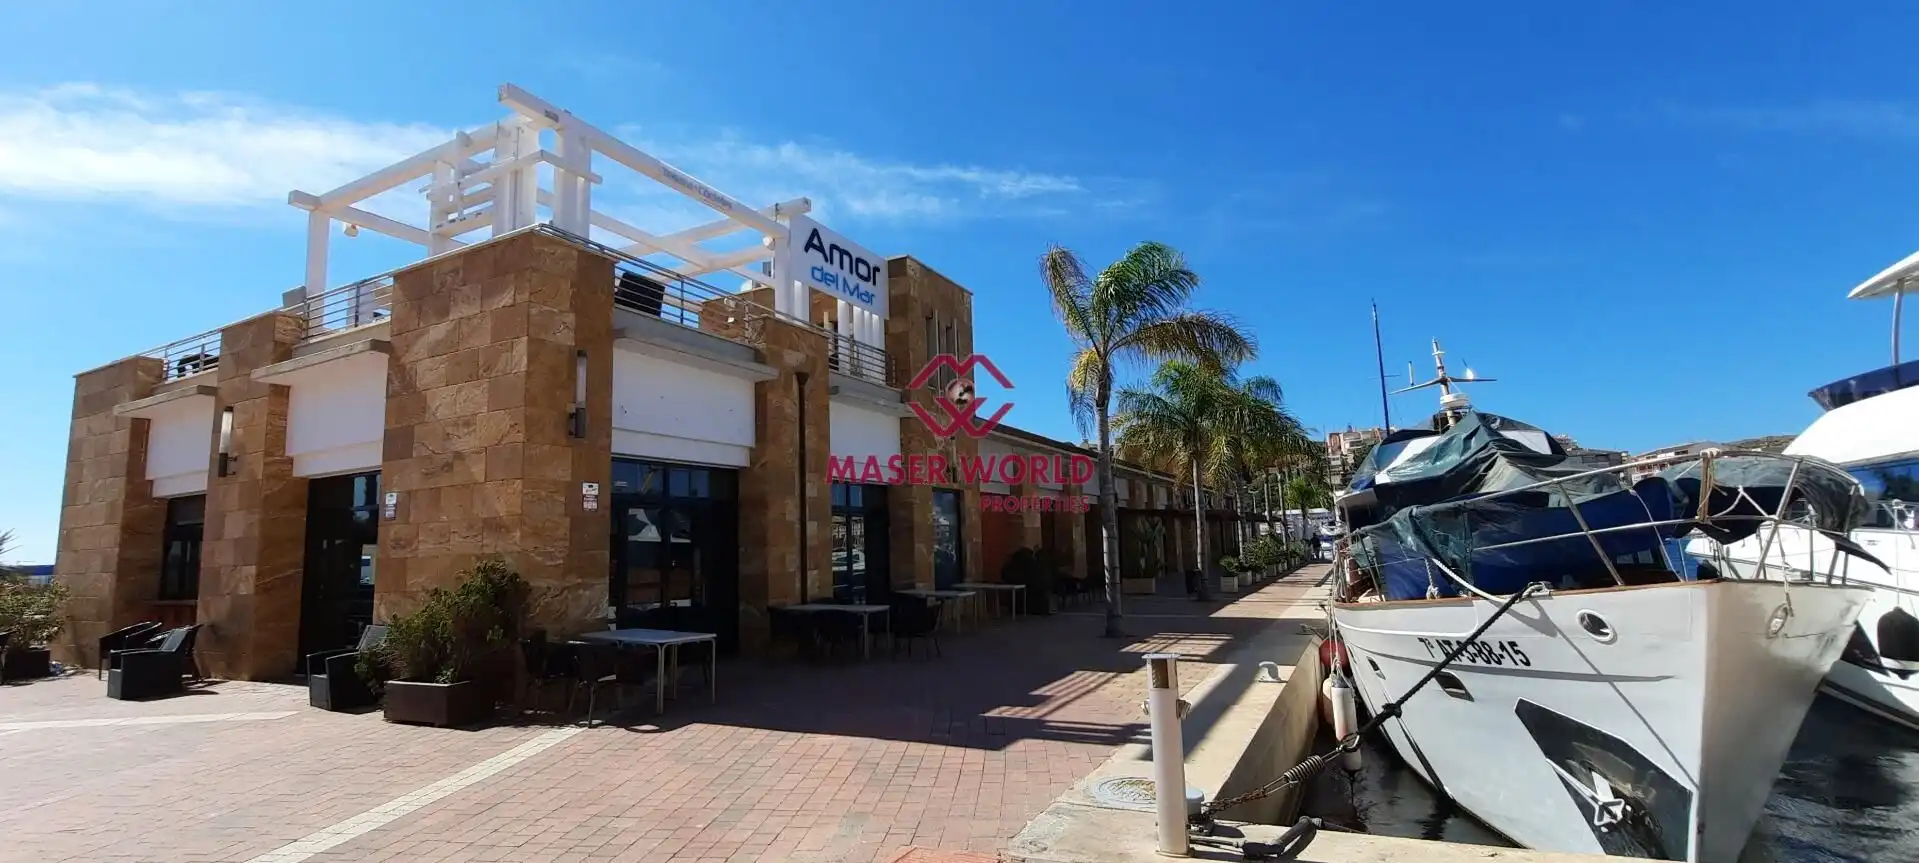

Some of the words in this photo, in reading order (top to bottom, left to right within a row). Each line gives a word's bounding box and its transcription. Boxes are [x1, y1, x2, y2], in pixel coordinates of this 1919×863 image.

[804, 228, 880, 286] Amor
[811, 265, 839, 292] del
[842, 276, 876, 306] Mar
